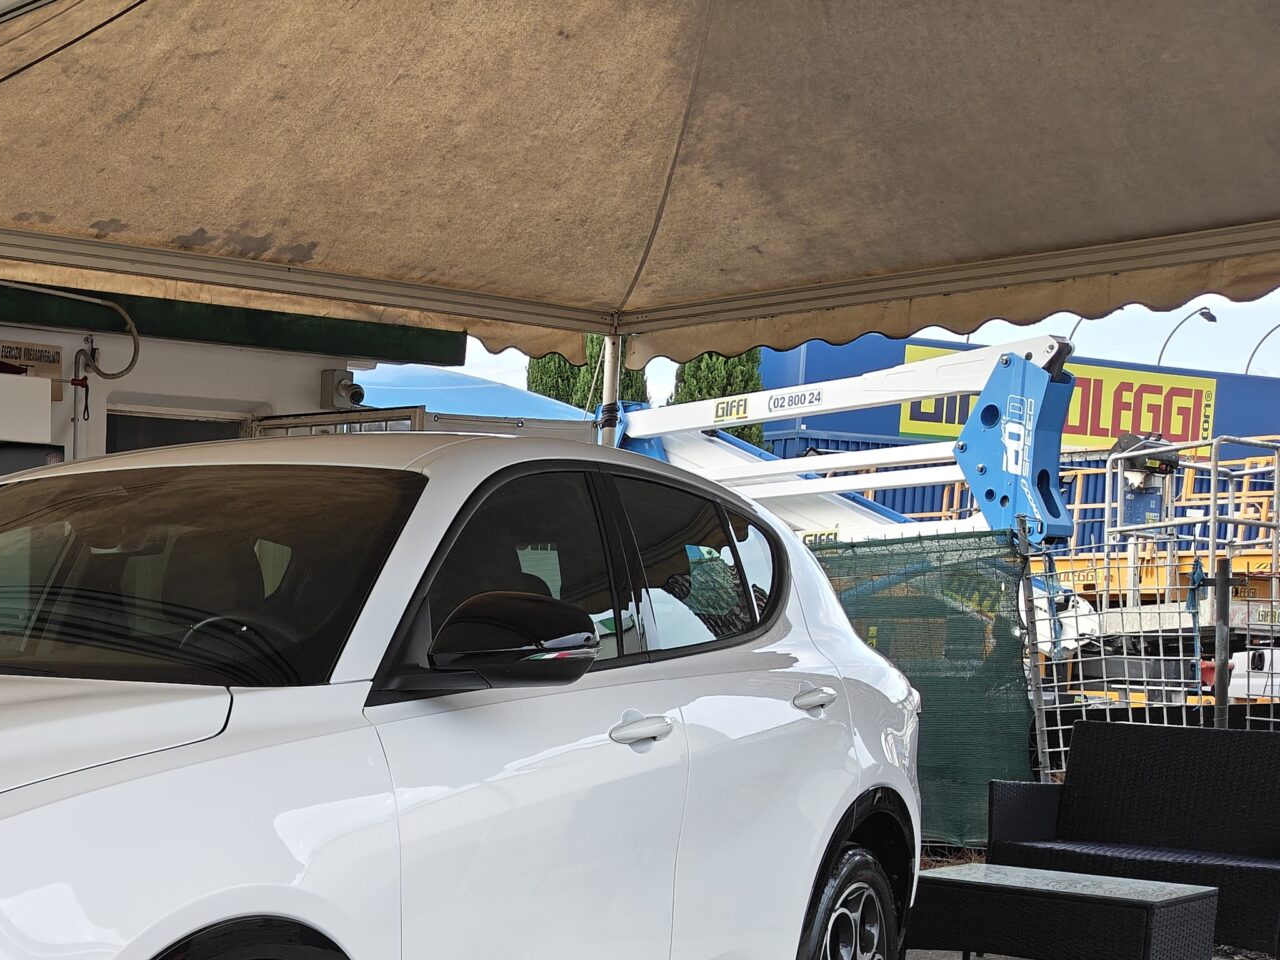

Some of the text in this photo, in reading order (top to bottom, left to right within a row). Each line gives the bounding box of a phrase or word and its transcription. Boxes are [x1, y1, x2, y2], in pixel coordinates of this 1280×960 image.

[715, 390, 821, 419] GIFFI 02 800 24
